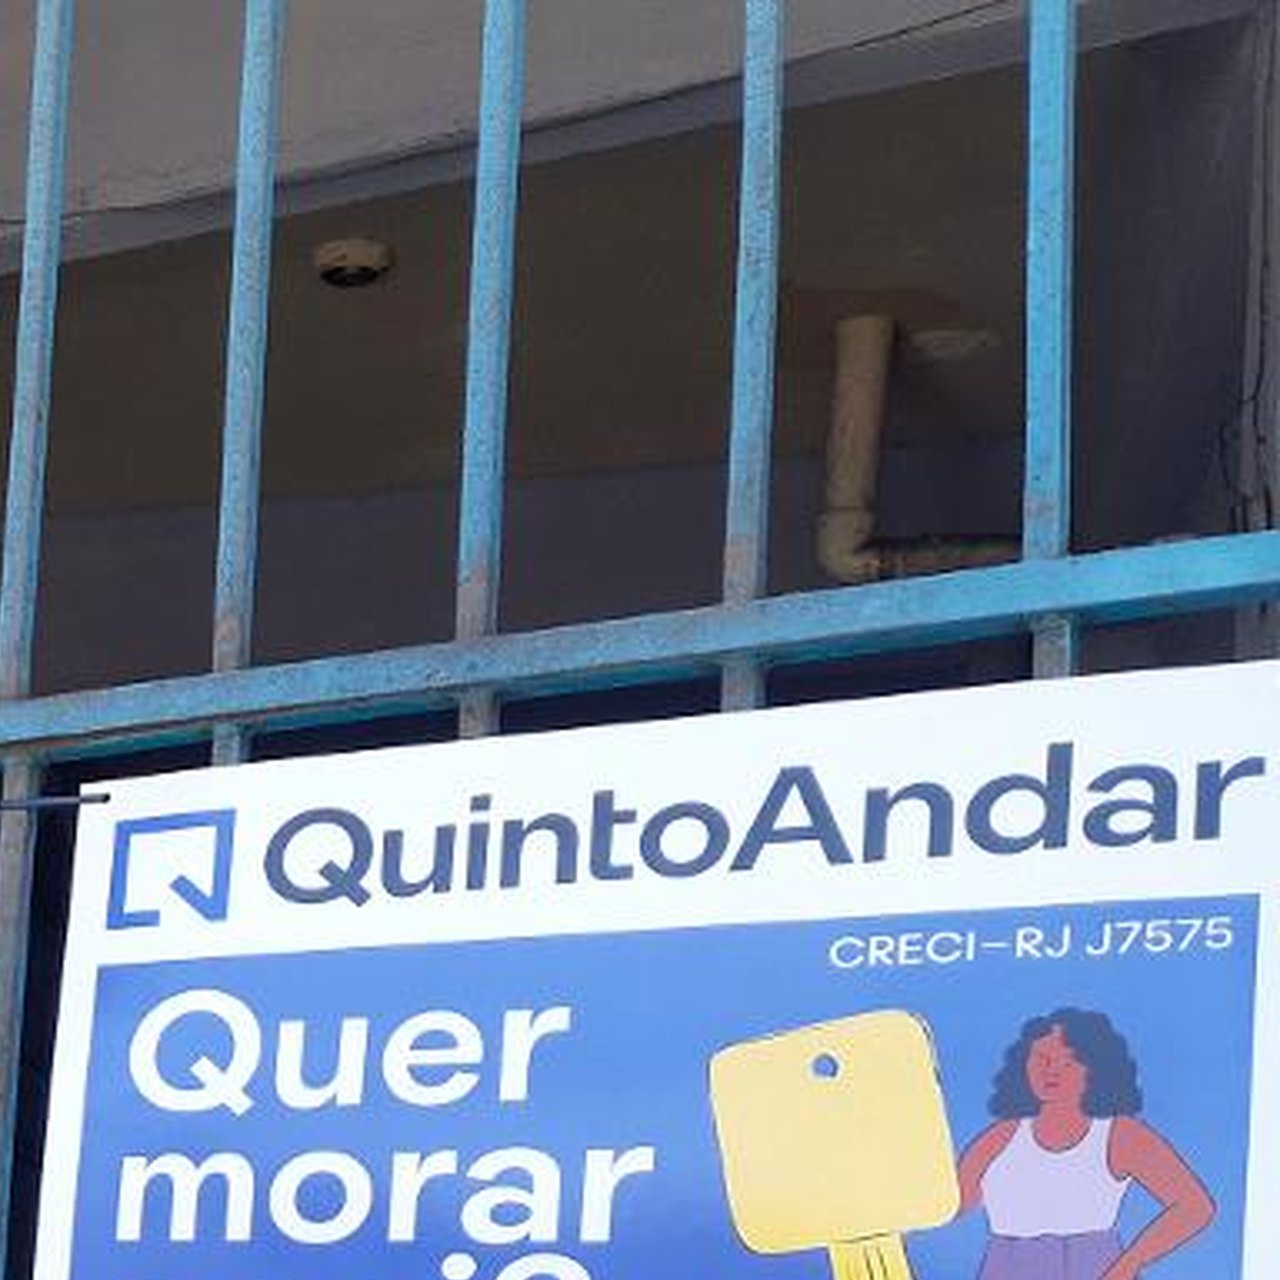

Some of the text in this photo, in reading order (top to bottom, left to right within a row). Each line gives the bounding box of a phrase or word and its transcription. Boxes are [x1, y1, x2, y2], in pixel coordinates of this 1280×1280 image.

[262, 740, 1267, 908] QuintoAndar
[828, 915, 1234, 969] CRECI-RJ J7575
[127, 988, 572, 1117] Quer
[115, 1145, 655, 1245] morar
